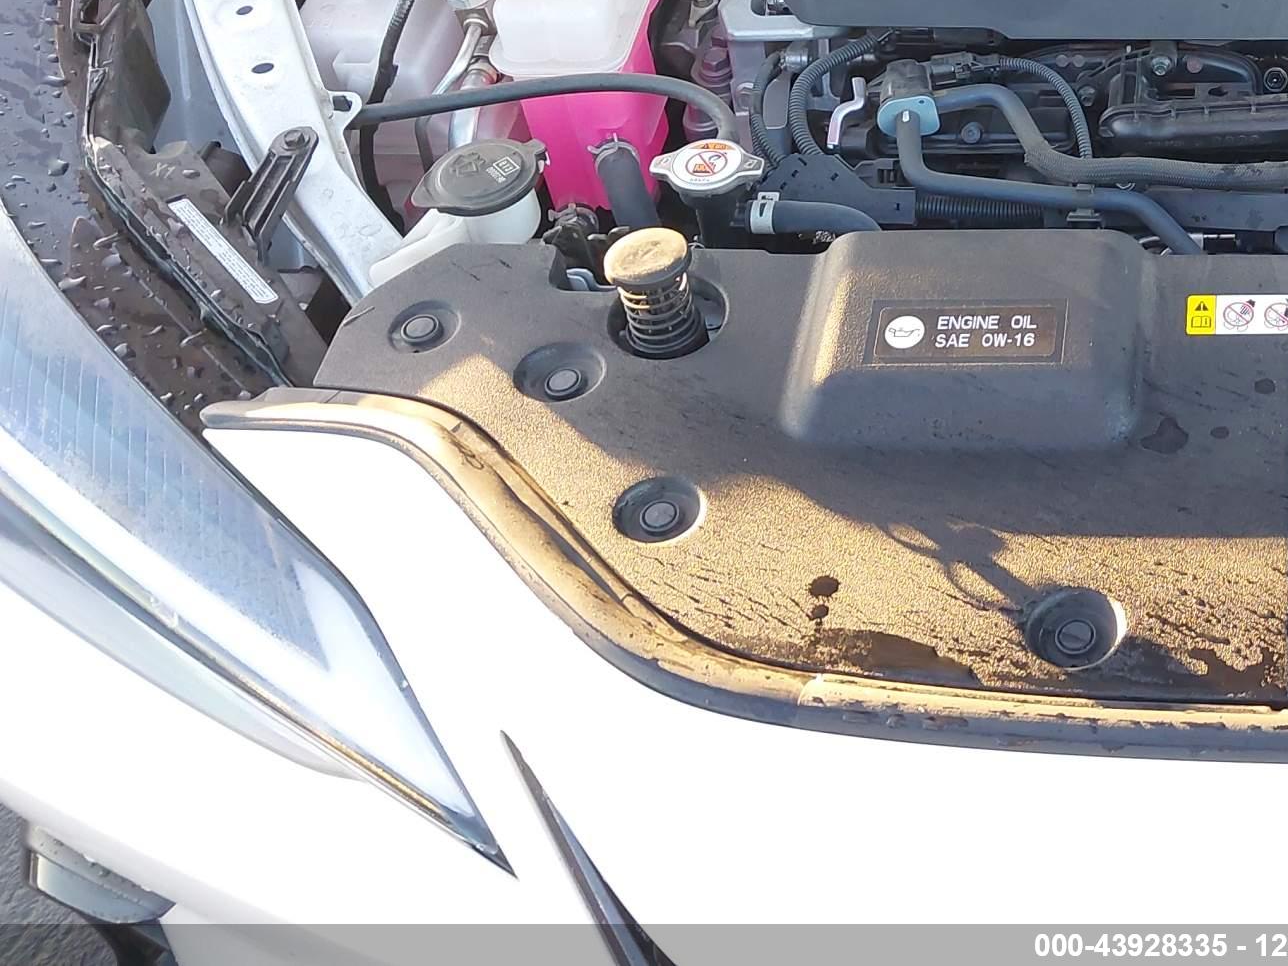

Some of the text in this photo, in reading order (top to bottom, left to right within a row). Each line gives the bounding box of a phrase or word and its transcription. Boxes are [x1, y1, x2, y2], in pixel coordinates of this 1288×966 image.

[937, 315, 1037, 330] ENGINE OIL
[934, 332, 1035, 348] SAE 0W-16
